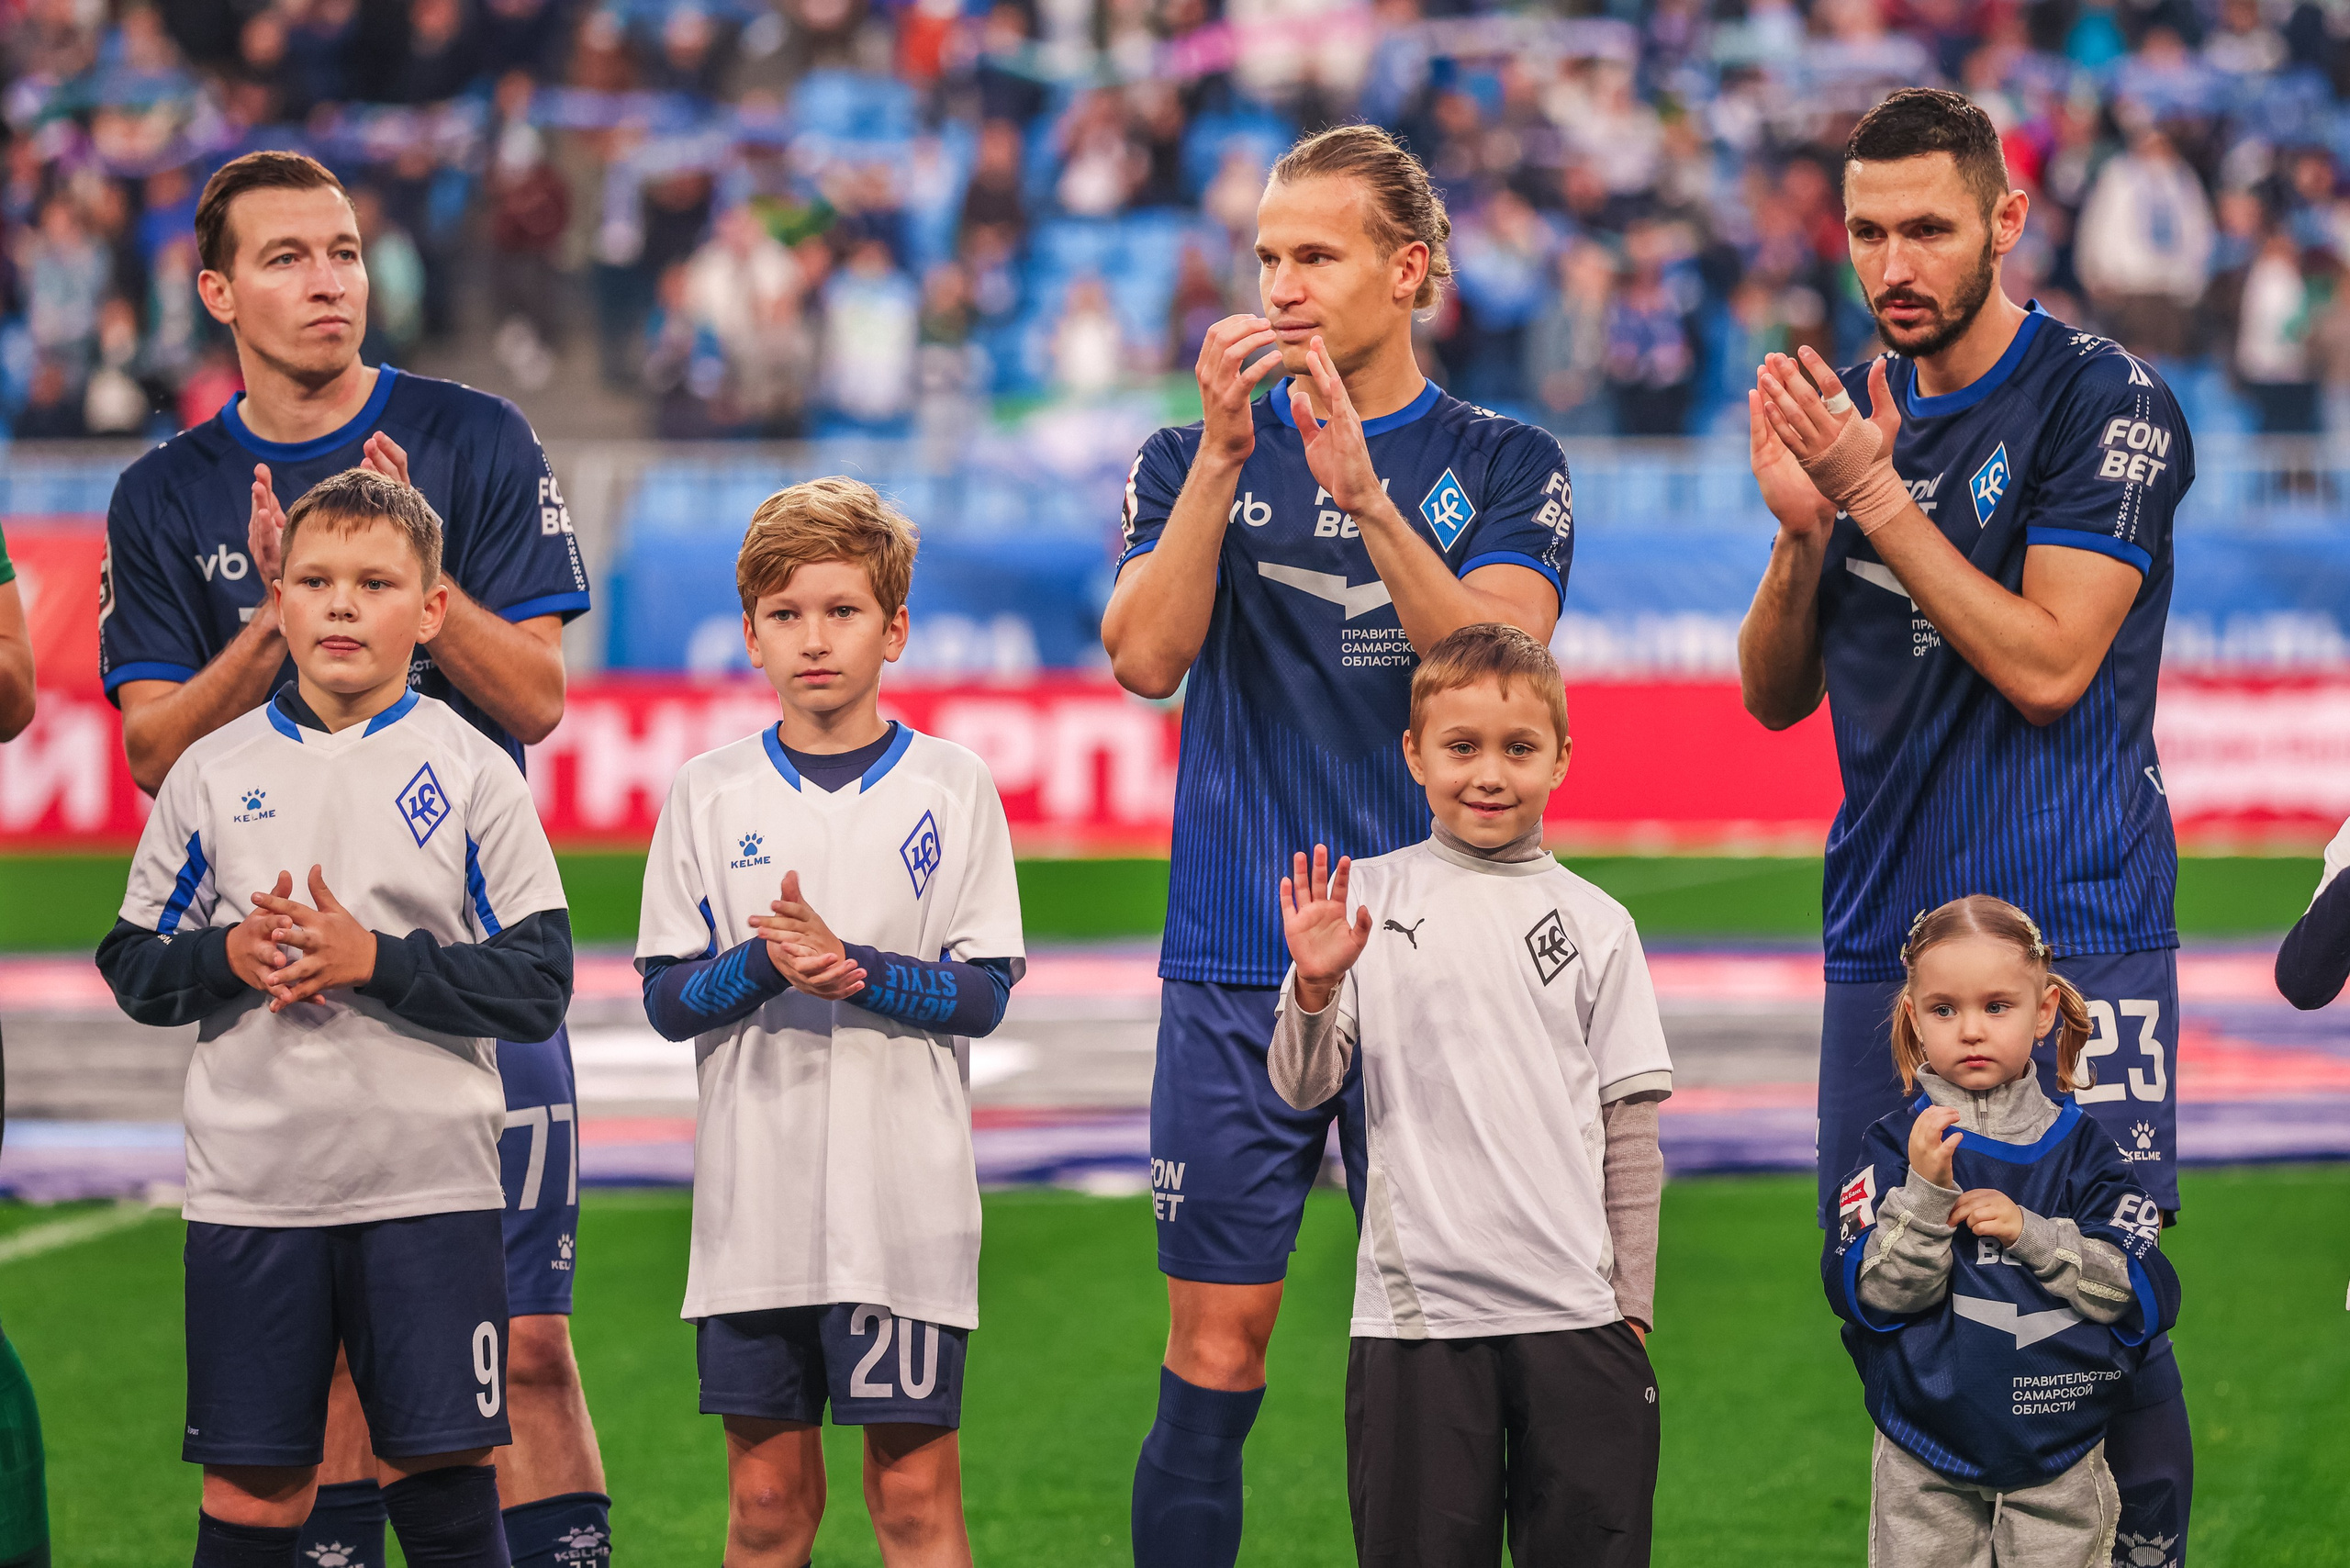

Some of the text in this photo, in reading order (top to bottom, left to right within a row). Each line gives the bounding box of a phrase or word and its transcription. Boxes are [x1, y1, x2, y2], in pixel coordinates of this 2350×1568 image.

[2078, 340, 2100, 356] KEL
[2104, 419, 2170, 458] FON
[2099, 449, 2166, 487] BET
[539, 477, 564, 505] FO
[1546, 472, 1572, 510] FO
[1903, 472, 1944, 501] ON
[542, 508, 574, 535] BE
[1314, 510, 1360, 539] BE
[1537, 498, 1572, 539] BE
[1341, 642, 1415, 653] САМАРСК
[1342, 629, 1408, 640] ПРАВИТЕ
[1341, 655, 1410, 666] ОБЛАСТИ
[233, 810, 275, 823] KELME
[731, 856, 771, 868] KELME
[884, 960, 957, 997] STYLE
[2074, 999, 2167, 1105] 23
[504, 1103, 576, 1211] 77
[2125, 1150, 2161, 1161] KELME
[1152, 1190, 1185, 1222] ET
[2113, 1193, 2159, 1226] FO
[551, 1260, 571, 1271] KEL
[850, 1304, 939, 1400] 20
[472, 1321, 500, 1418] 9
[2013, 1370, 2121, 1388] ПРАВИТЕЛЬСТВО
[2012, 1384, 2093, 1401] САМАРСКОЙ
[2012, 1401, 2076, 1416] ОБЛАСТИ
